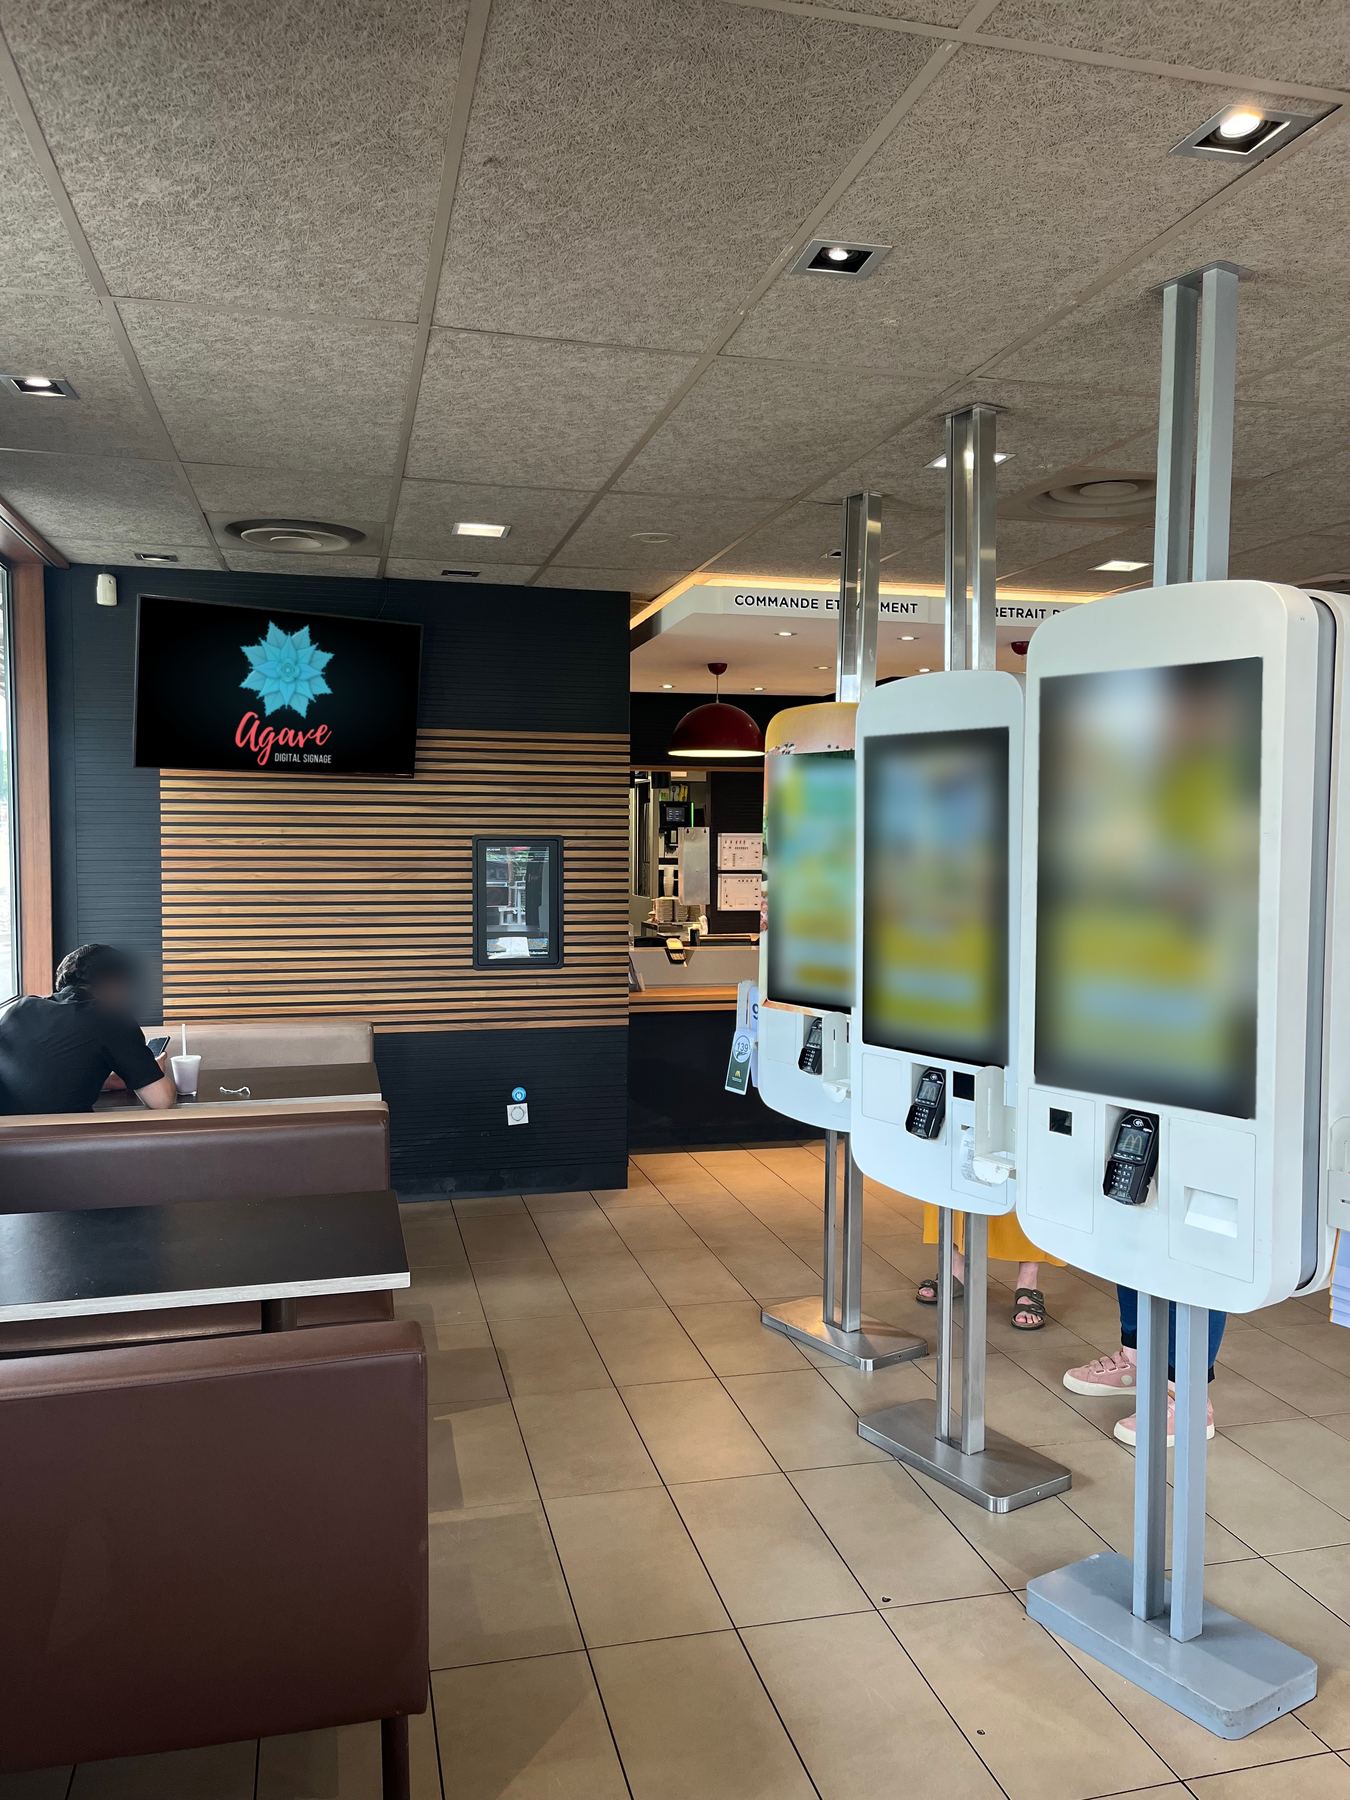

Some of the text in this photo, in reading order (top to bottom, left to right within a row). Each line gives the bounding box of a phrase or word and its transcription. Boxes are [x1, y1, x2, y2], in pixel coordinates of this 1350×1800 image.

[735, 595, 819, 609] COMMANDE
[235, 711, 332, 766] Agave
[274, 753, 332, 764] DIGITAL SIGNAGE
